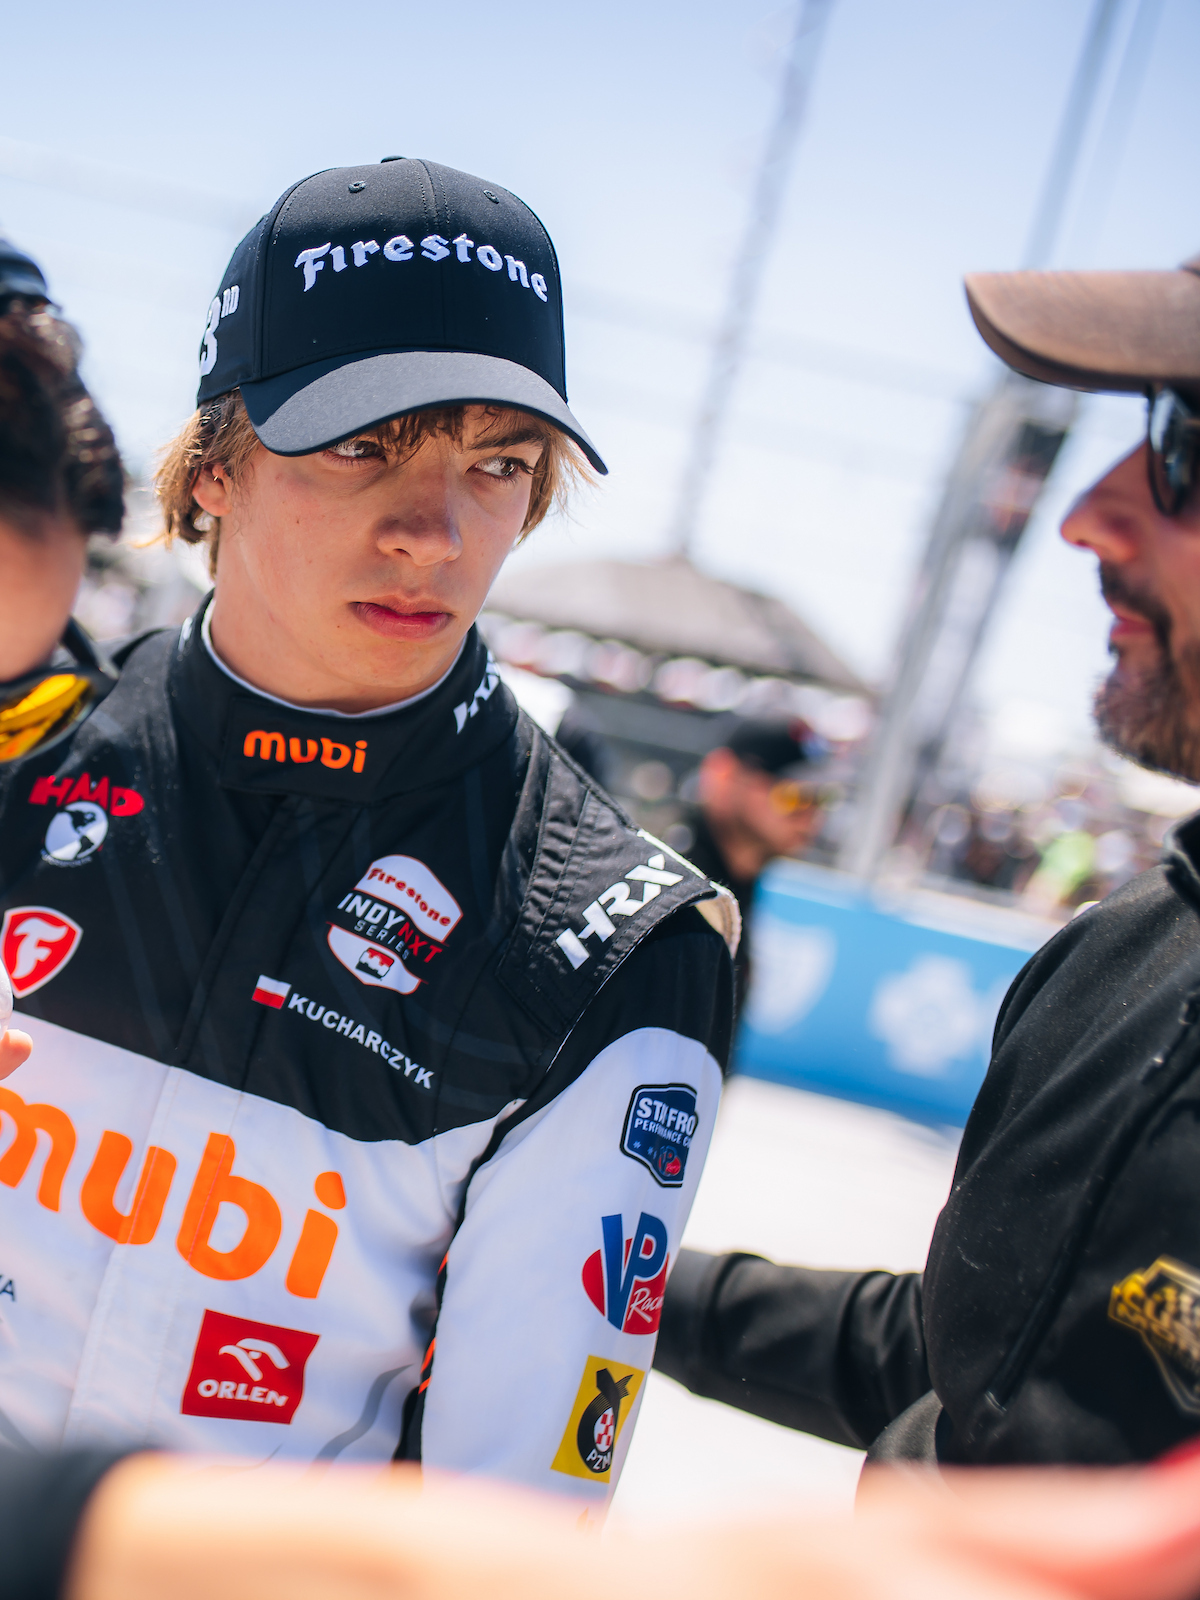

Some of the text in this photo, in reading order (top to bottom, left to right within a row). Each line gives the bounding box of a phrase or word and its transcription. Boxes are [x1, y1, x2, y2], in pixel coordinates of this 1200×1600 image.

[294, 232, 550, 303] Firestone
[243, 729, 368, 773] mubi
[28, 772, 145, 817] HMD
[367, 868, 451, 926] Firestone
[556, 853, 684, 970] HRX
[354, 920, 409, 960] SERIES
[287, 993, 435, 1089] KUCHARCZYK
[601, 1211, 668, 1331] VP
[197, 1378, 290, 1407] ORLEN
